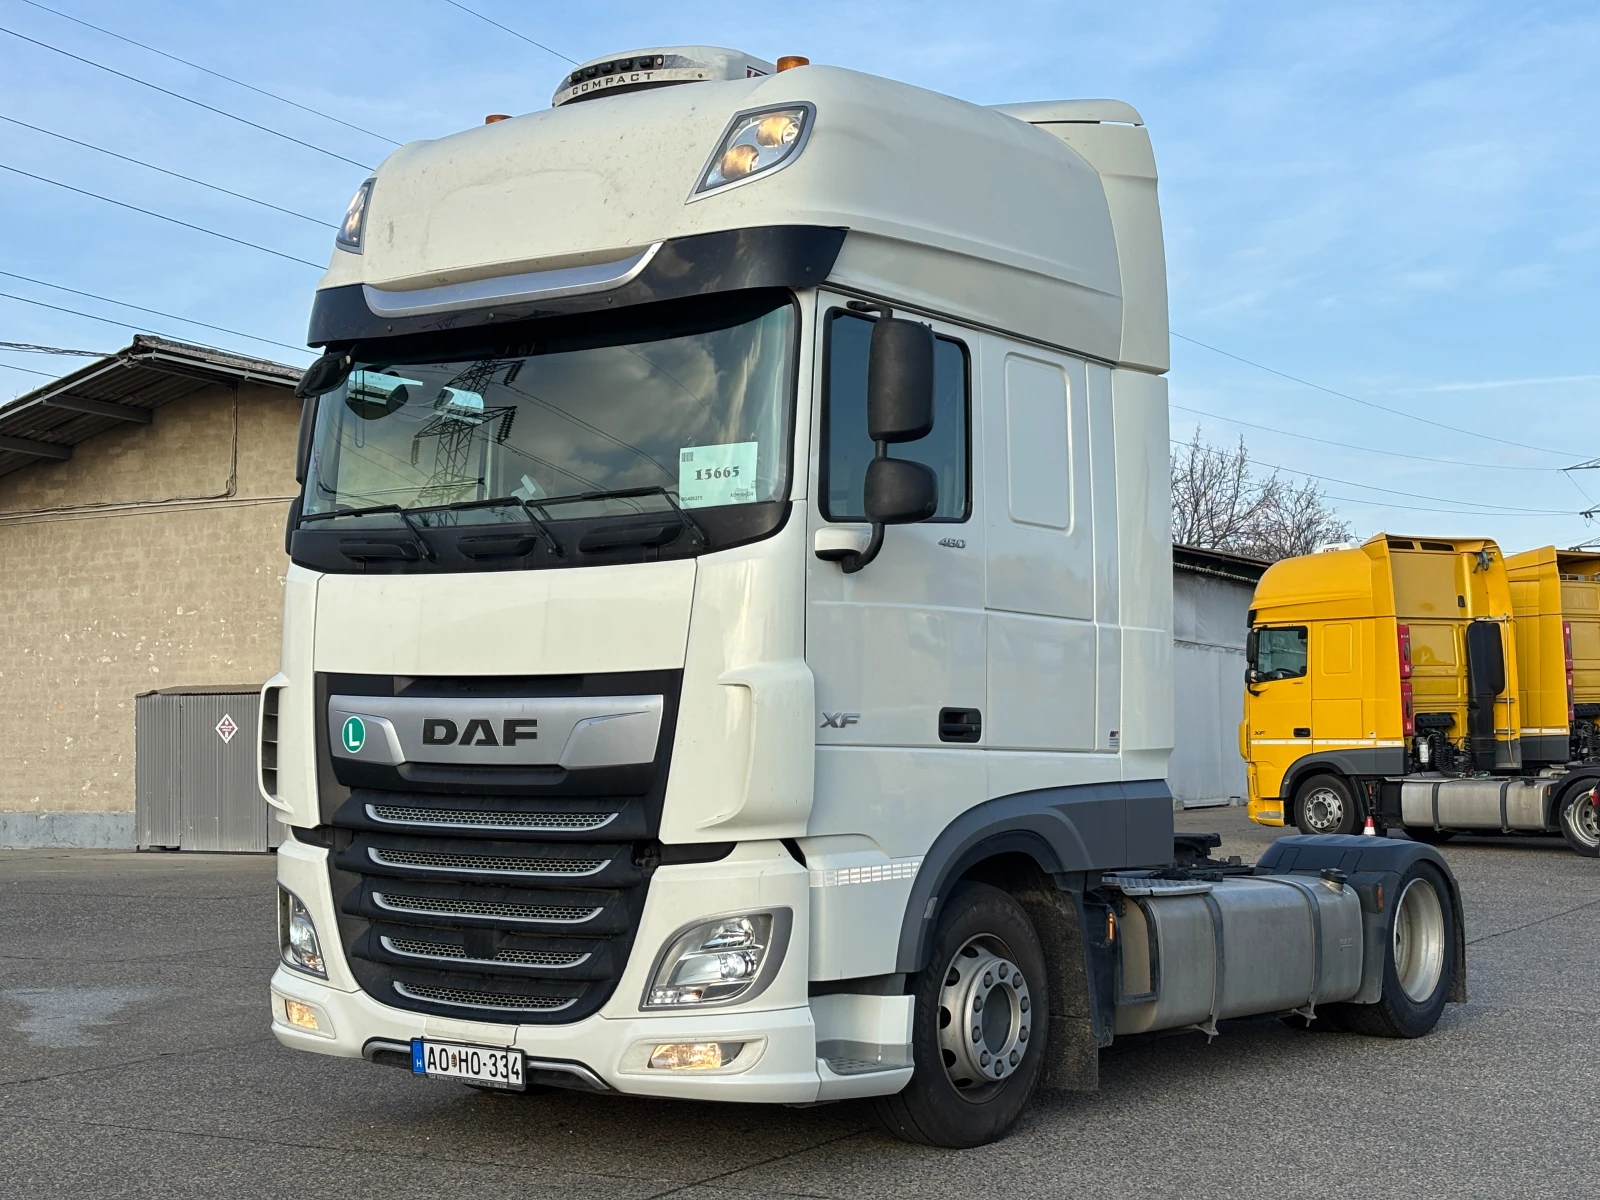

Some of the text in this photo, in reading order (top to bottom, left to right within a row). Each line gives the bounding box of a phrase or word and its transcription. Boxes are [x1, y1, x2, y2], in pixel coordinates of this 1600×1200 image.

[572, 71, 654, 96] COMPACT
[694, 465, 740, 481] 15665
[937, 537, 966, 549] 460
[819, 711, 861, 729] XF
[348, 723, 360, 747] L
[422, 718, 538, 747] DAF
[416, 1060, 422, 1068] H
